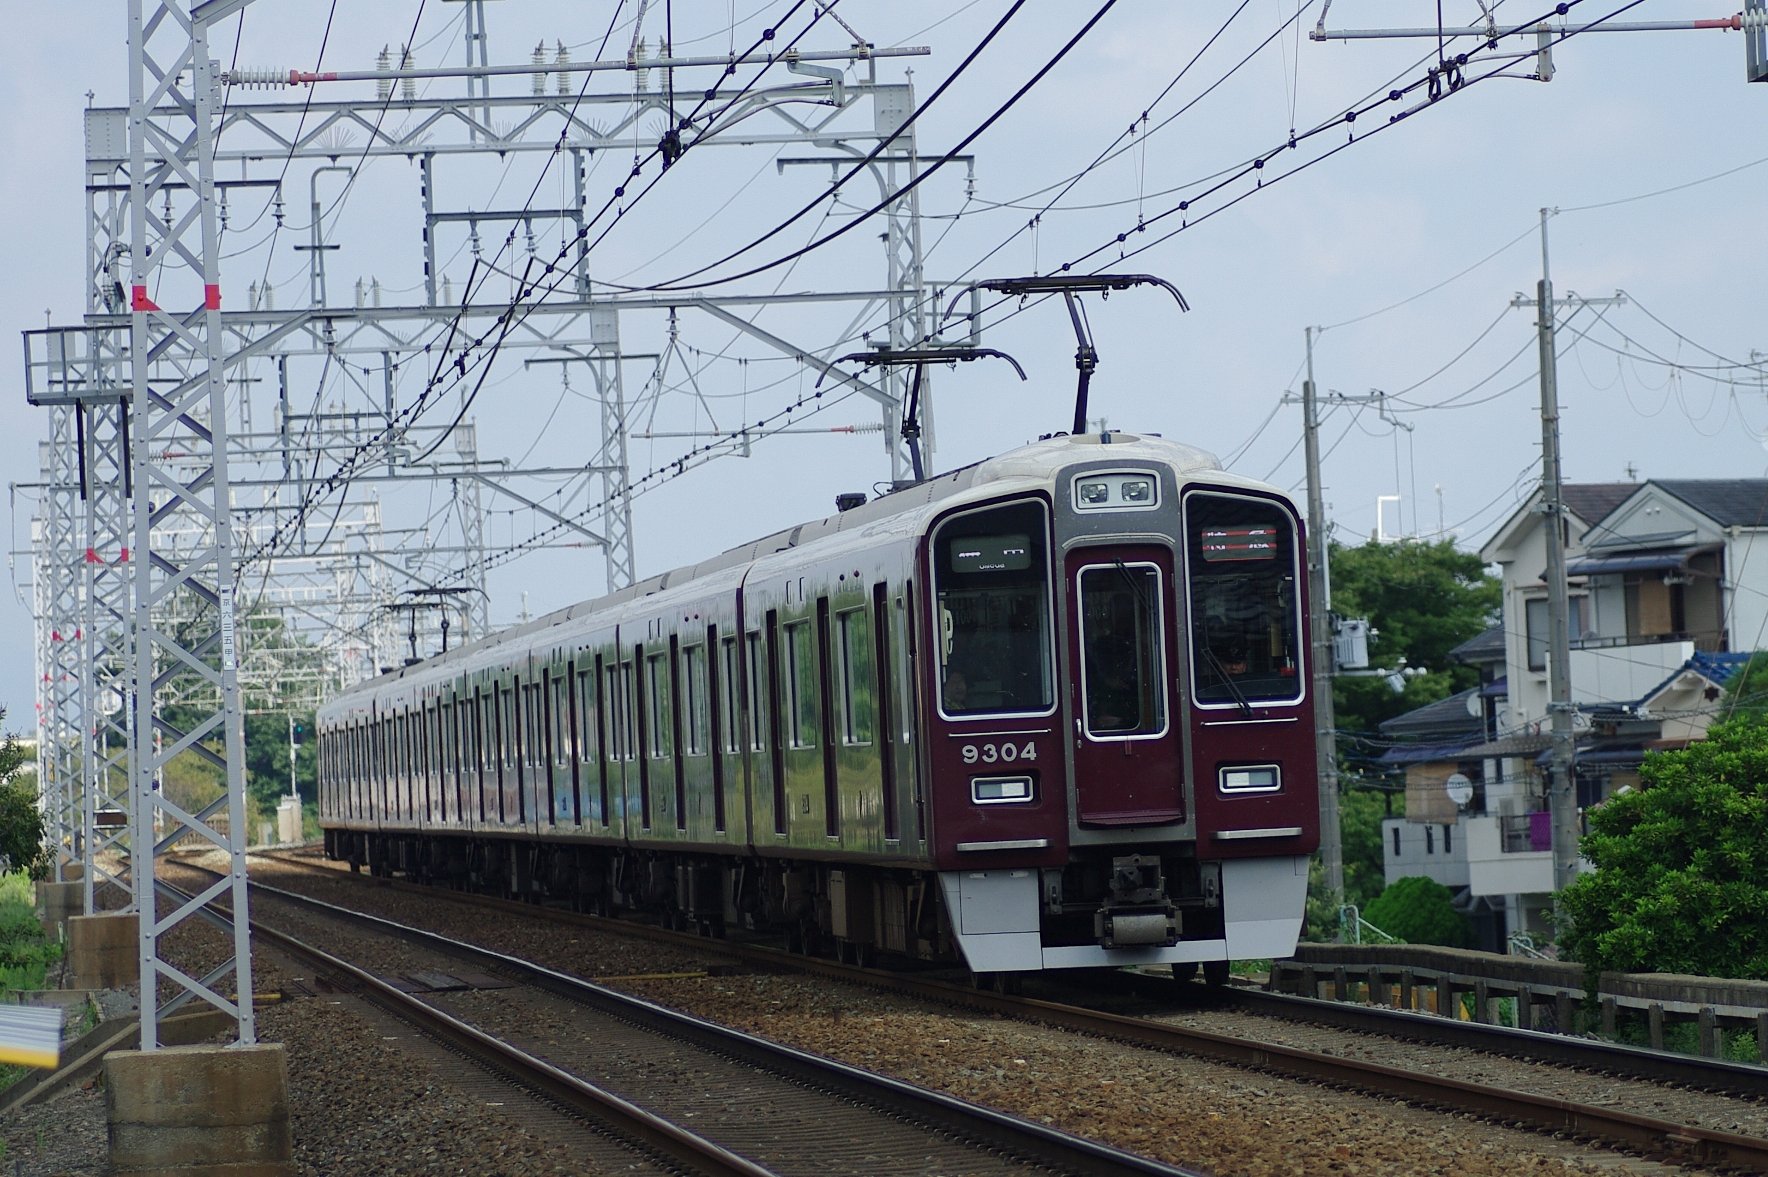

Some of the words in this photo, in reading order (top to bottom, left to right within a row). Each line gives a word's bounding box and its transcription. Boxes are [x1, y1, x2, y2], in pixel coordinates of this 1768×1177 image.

[222, 598, 233, 656] 京六三五甲
[962, 741, 1037, 764] 9304
